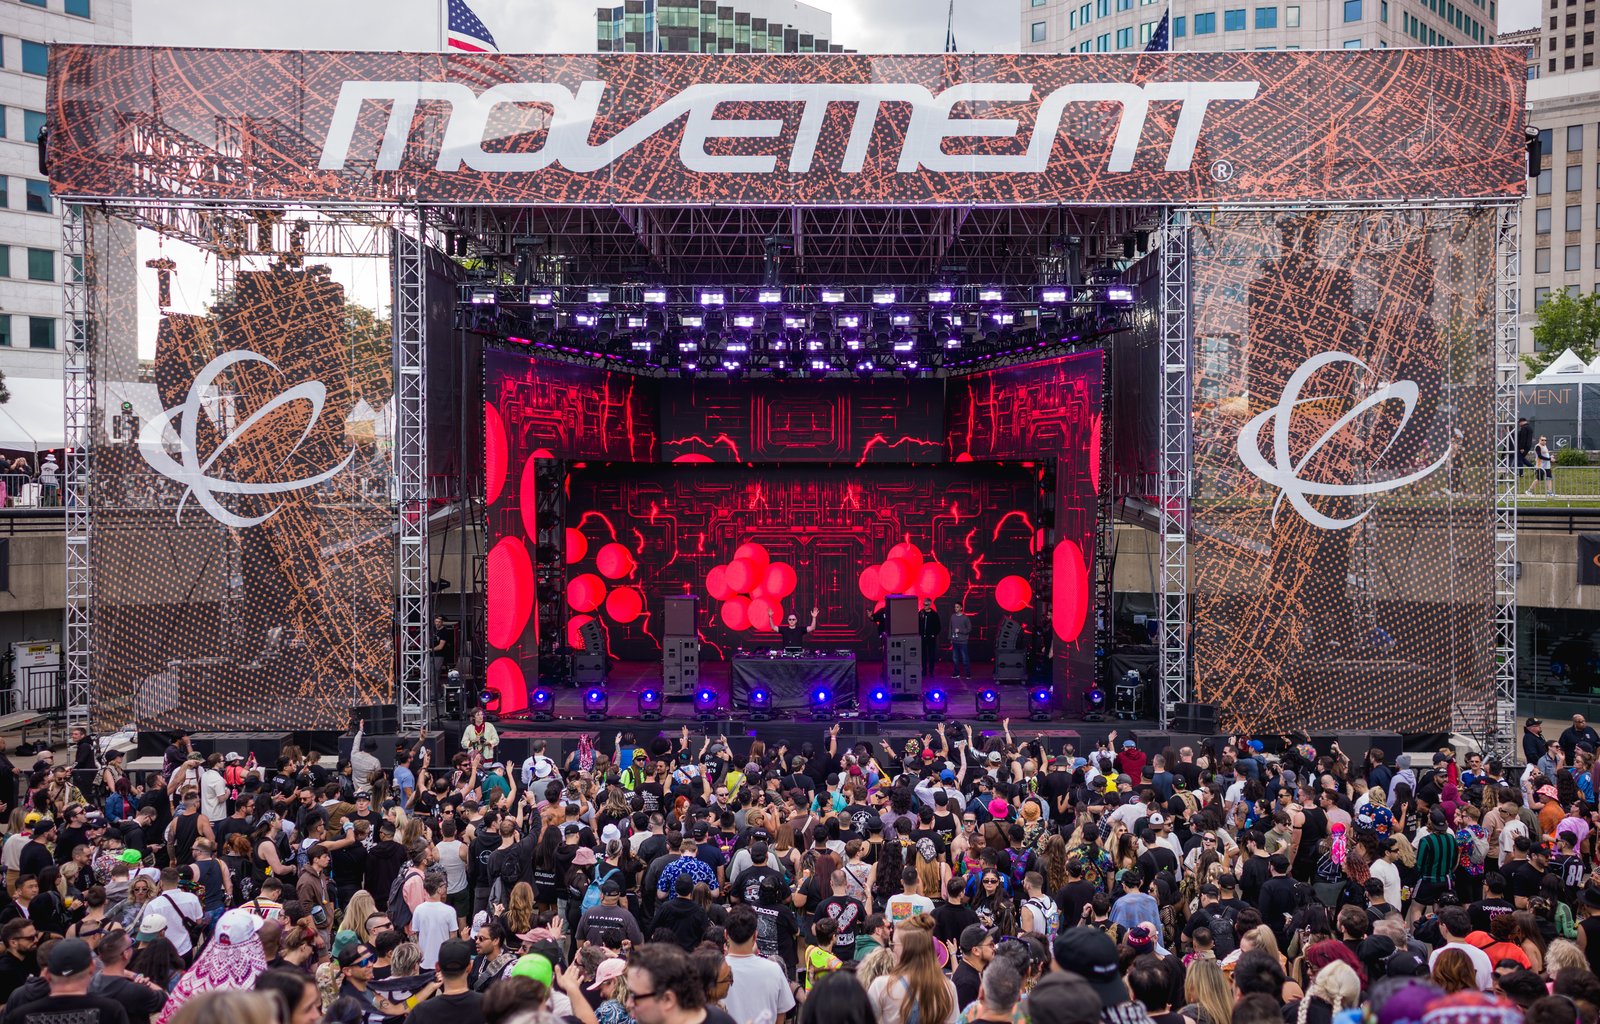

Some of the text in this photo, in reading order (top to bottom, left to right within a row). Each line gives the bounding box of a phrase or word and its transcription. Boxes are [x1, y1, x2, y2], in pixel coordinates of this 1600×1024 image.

[318, 80, 1260, 174] MOVEMENT
[1519, 388, 1572, 405] MENT
[1565, 864, 1584, 888] 84
